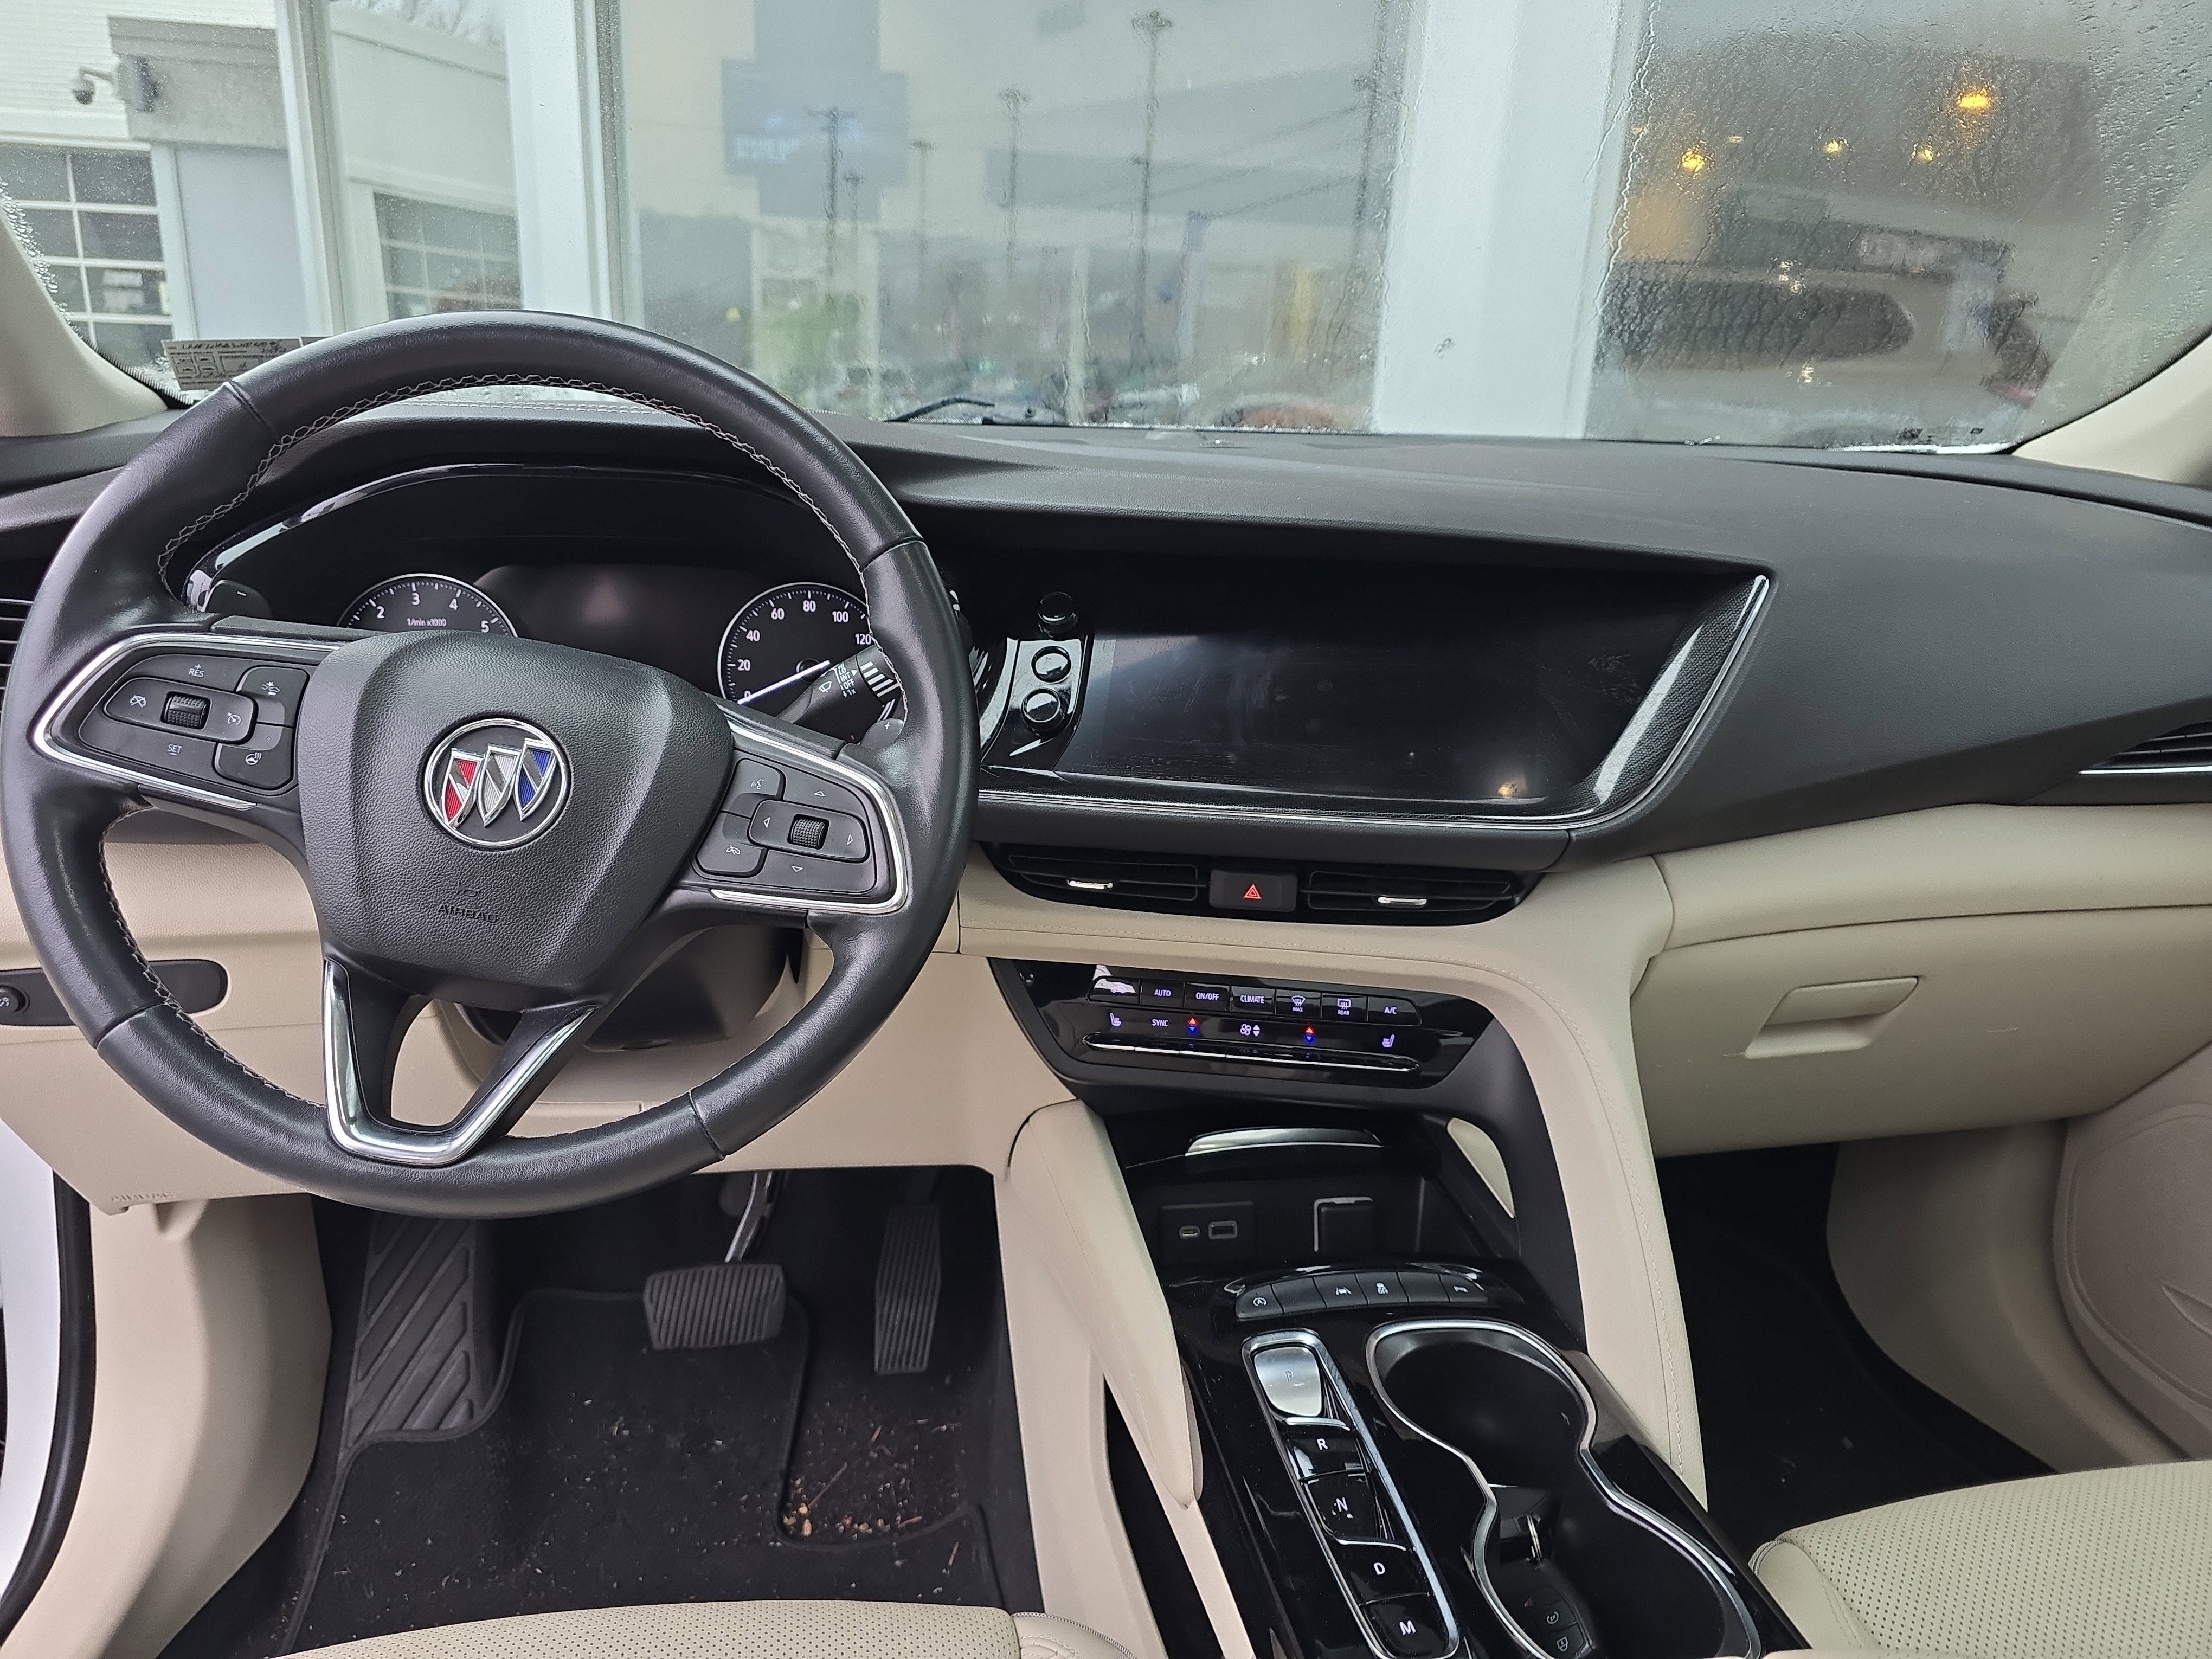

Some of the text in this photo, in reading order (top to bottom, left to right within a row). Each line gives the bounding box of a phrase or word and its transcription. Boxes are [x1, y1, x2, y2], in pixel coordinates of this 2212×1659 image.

[411, 593, 420, 606] 3
[449, 598, 458, 610] 4
[803, 600, 816, 612] 80
[376, 606, 385, 619] 2
[771, 608, 785, 620] 60
[832, 610, 849, 623] 100
[407, 618, 447, 627] 1/min x1000
[481, 620, 490, 633] 5
[745, 629, 760, 642] 40
[855, 633, 871, 645] 120
[737, 659, 751, 671] 20
[188, 667, 204, 678] RES
[838, 667, 847, 676] LO
[840, 671, 851, 683] INT
[843, 678, 855, 689] OFF
[166, 743, 182, 754] SET
[437, 904, 499, 922] AIRBAG
[1195, 992, 1219, 1001] ON/OFF
[1240, 995, 1265, 1004] CLIMATE
[1384, 1006, 1398, 1015] A/C
[1152, 1019, 1169, 1027] SYNC
[1285, 1370, 1294, 1382] P
[1317, 1438, 1328, 1451] R
[1336, 1496, 1348, 1513] N
[1373, 1562, 1386, 1576] D
[1399, 1619, 1417, 1636] M
